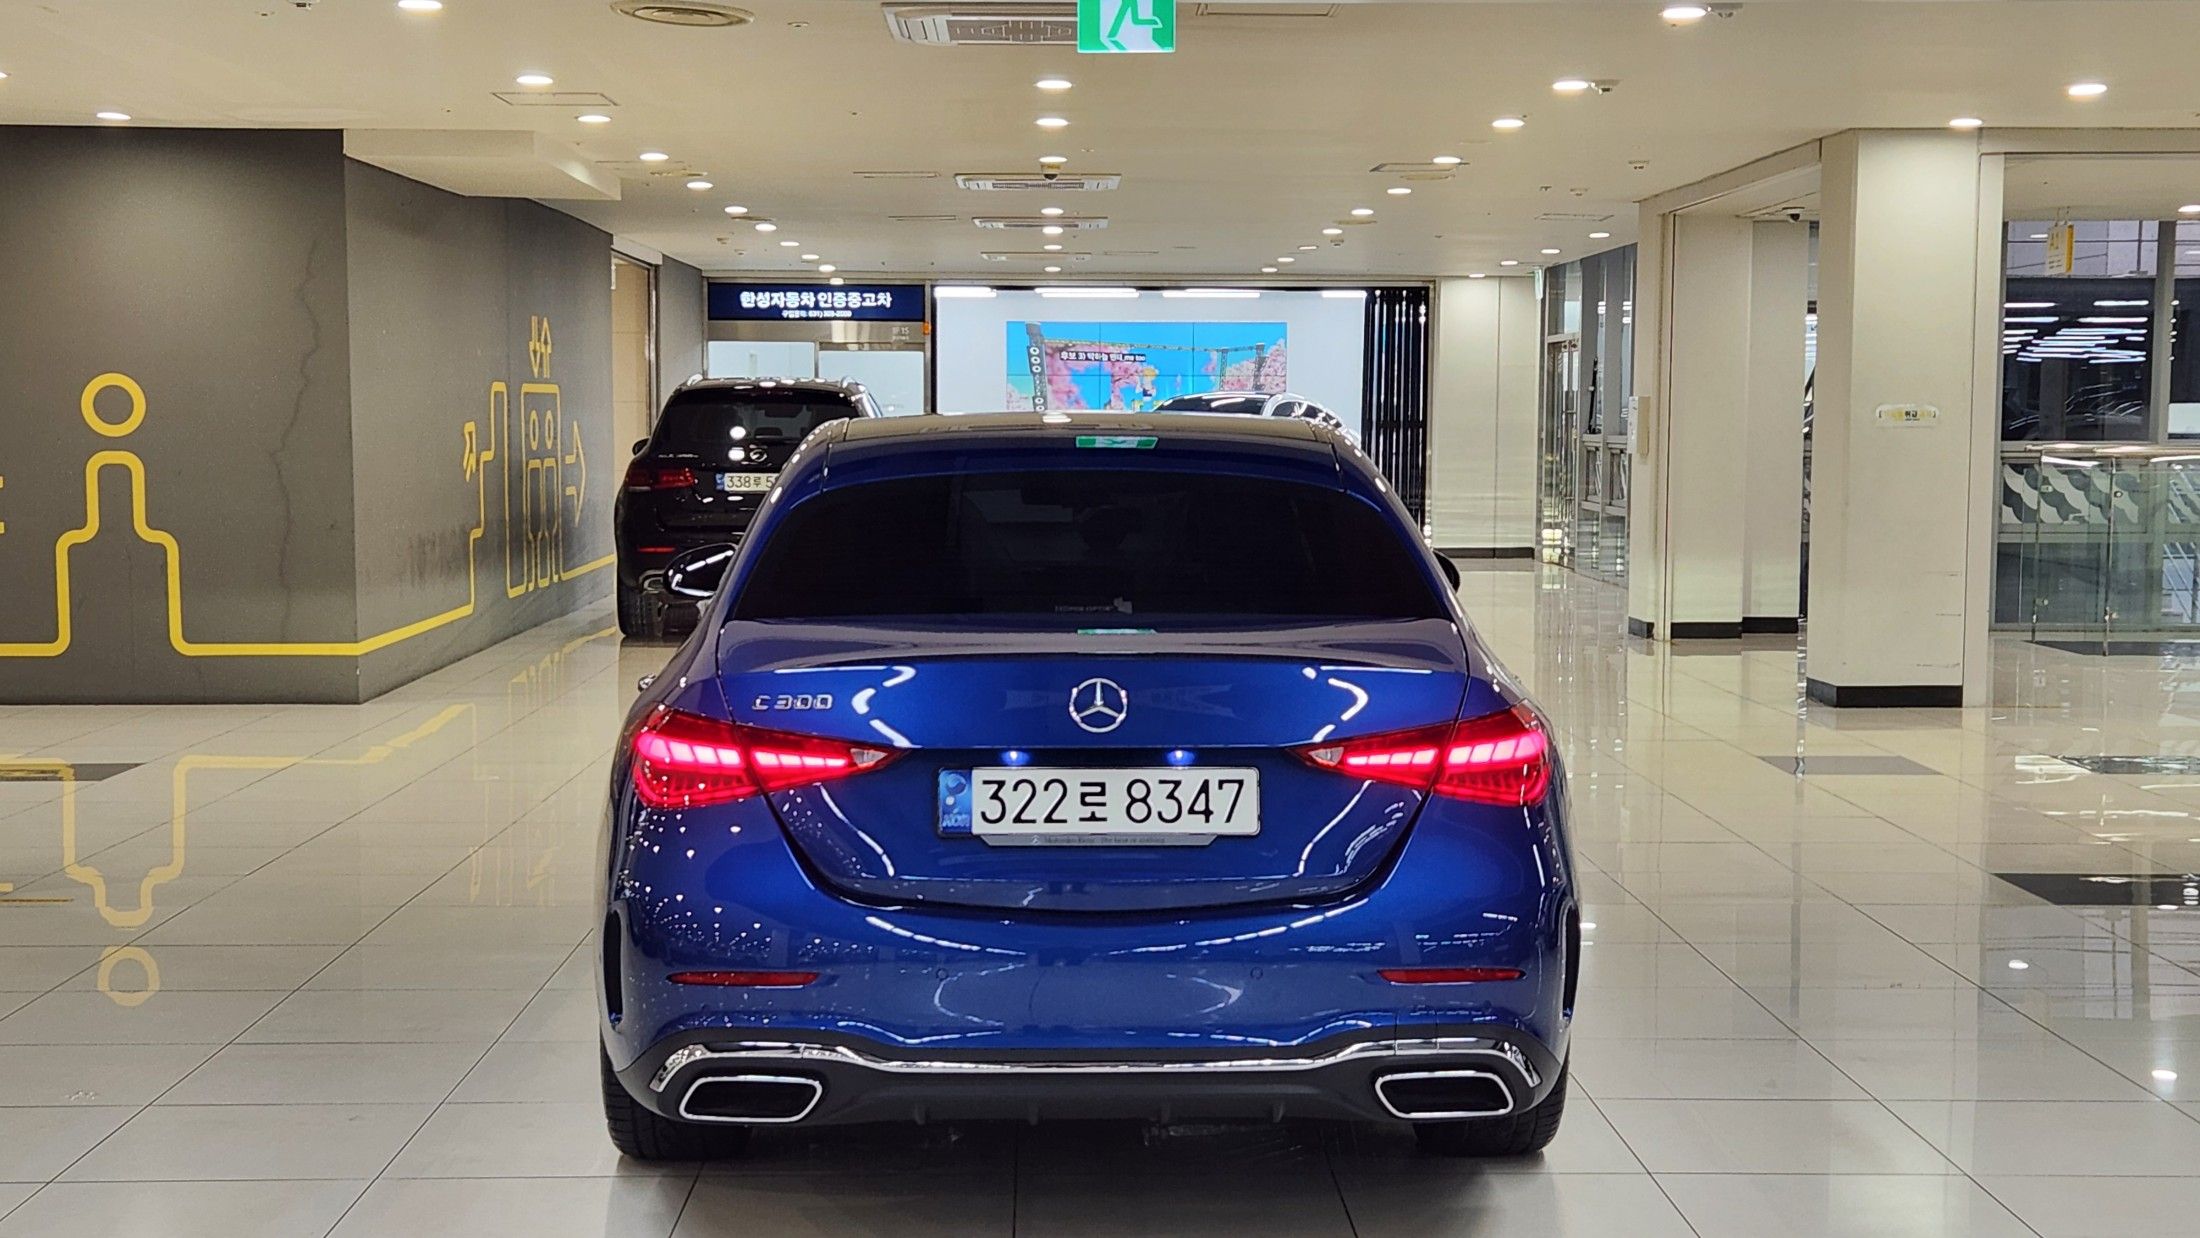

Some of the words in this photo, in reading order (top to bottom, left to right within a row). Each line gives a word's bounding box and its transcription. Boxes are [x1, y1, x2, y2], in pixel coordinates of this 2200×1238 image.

[740, 291, 815, 309] 한성자동차
[817, 291, 892, 308] 인증중고차
[727, 476, 761, 488] 338루
[752, 695, 771, 710] C
[774, 694, 833, 710] 300
[980, 778, 1108, 824] 322로
[1125, 778, 1245, 824] 8347
